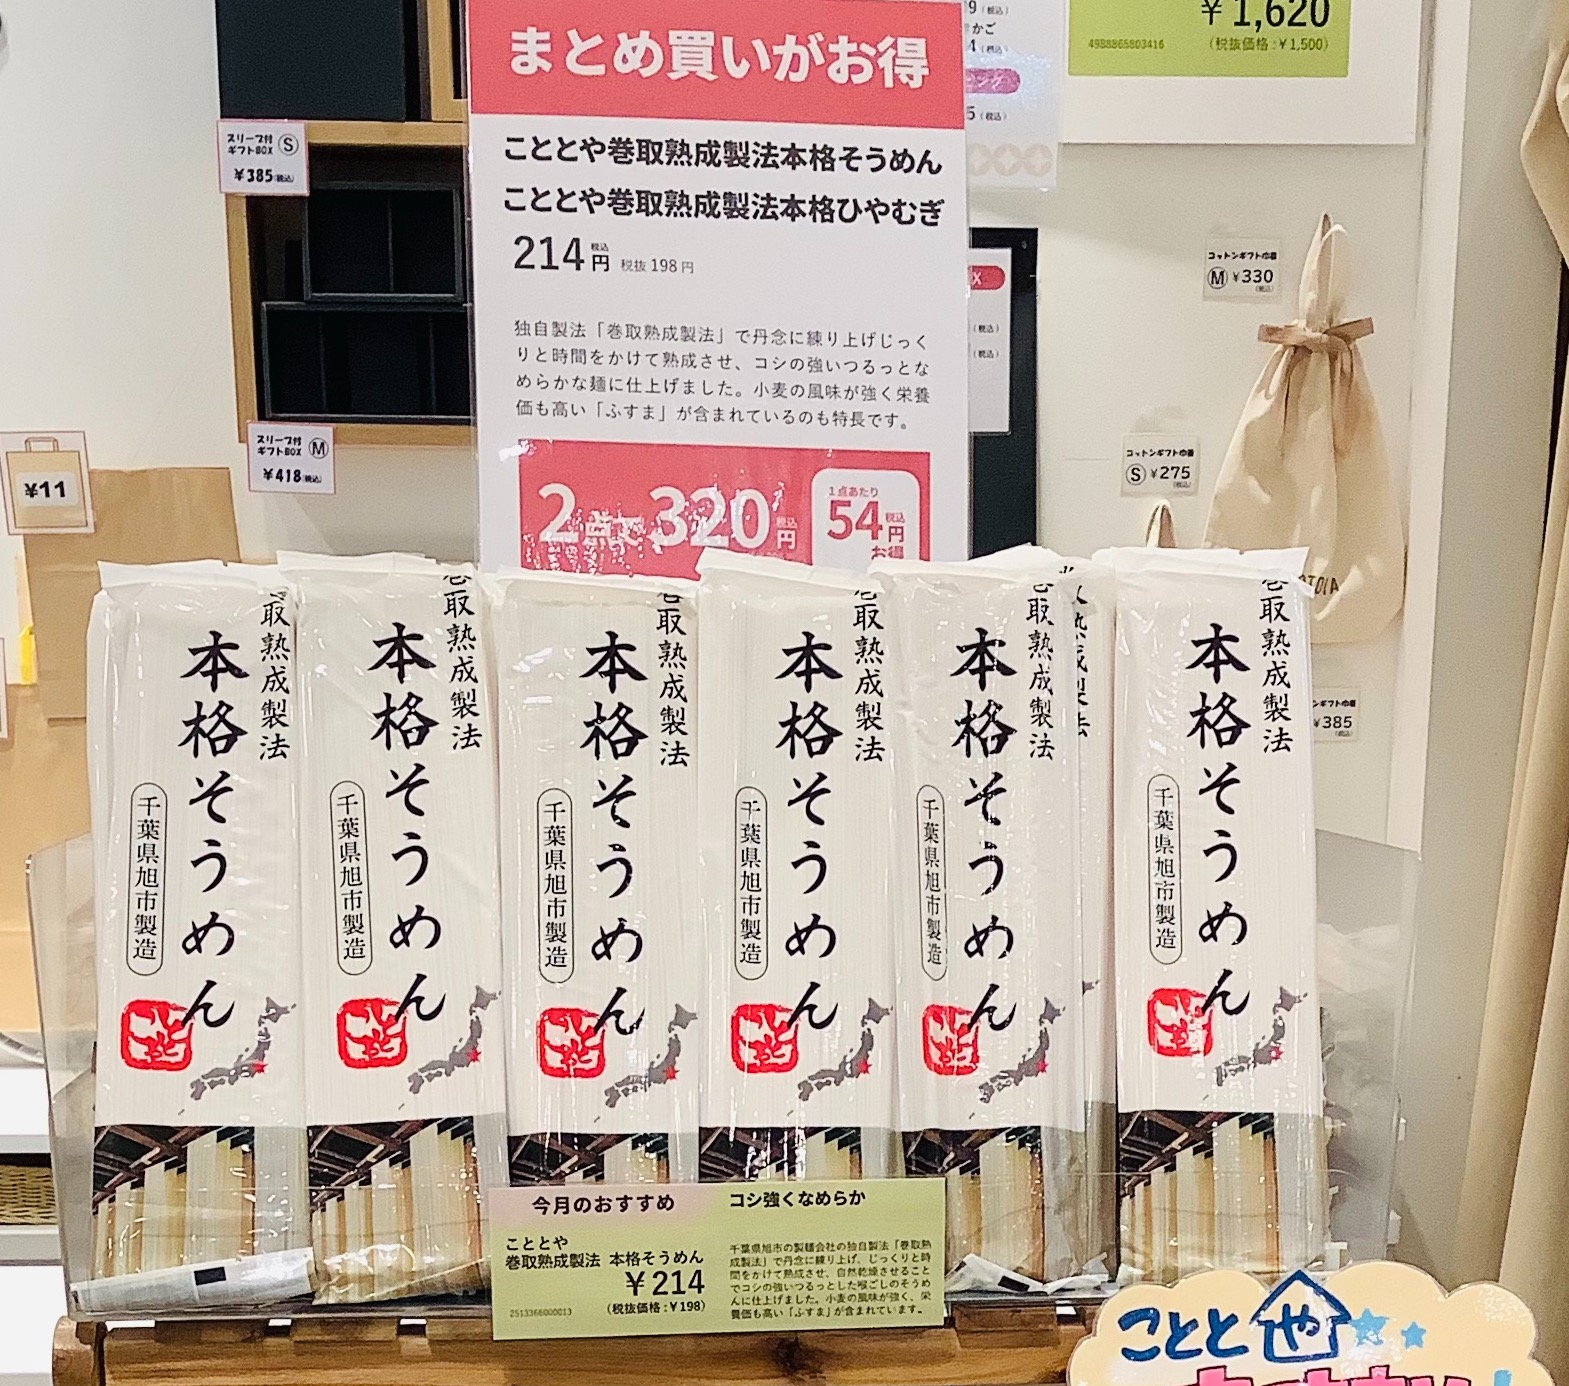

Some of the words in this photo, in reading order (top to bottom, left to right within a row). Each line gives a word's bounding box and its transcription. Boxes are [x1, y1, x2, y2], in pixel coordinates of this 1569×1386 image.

[510, 27, 930, 90] まとめ買いがお得
[505, 136, 942, 176] こととや巻取熟成製法本格そうめん
[503, 185, 943, 228] こととや巻取熟成製法本格ひやむぎ
[513, 320, 928, 352] 独自製法「巻取熟成製法」で丹念に練り上げじっく
[517, 347, 930, 378] りと時間をかけて熟成させ、コシの強いつるっとな
[516, 373, 931, 405] めらかな麺に仕上げました。小麦の風味が強く栄養
[516, 399, 908, 430] 価も高い「ふすま」が含まれているのも特長です。
[25, 481, 66, 499] ¥11
[178, 630, 249, 1028] 本格そうめん
[368, 622, 446, 1021] 本格そうめん
[580, 630, 648, 1037] 本格そうめん
[774, 630, 844, 1030] 本格そうめん
[950, 627, 1018, 1032] 本格そうめん
[1185, 623, 1251, 1016] 本格そうめん
[132, 796, 161, 961] 千葉県旭市製造
[336, 793, 366, 961] 千葉県旭市製造
[543, 802, 568, 969] 千葉県旭市製造
[739, 801, 763, 965] 千葉県旭市製造
[921, 798, 944, 966] 千葉県旭市製造
[1153, 788, 1178, 951] 千葉県旭市製造
[532, 1194, 675, 1216] 今月のおすすめ
[730, 1190, 866, 1208] コシ強くなめらか
[505, 1252, 600, 1270] 巻取熟成製法
[609, 1249, 704, 1267] 本格そうめん
[506, 1235, 568, 1252] こととや
[625, 1269, 706, 1297] ¥214
[1117, 1303, 1320, 1363] こととや
